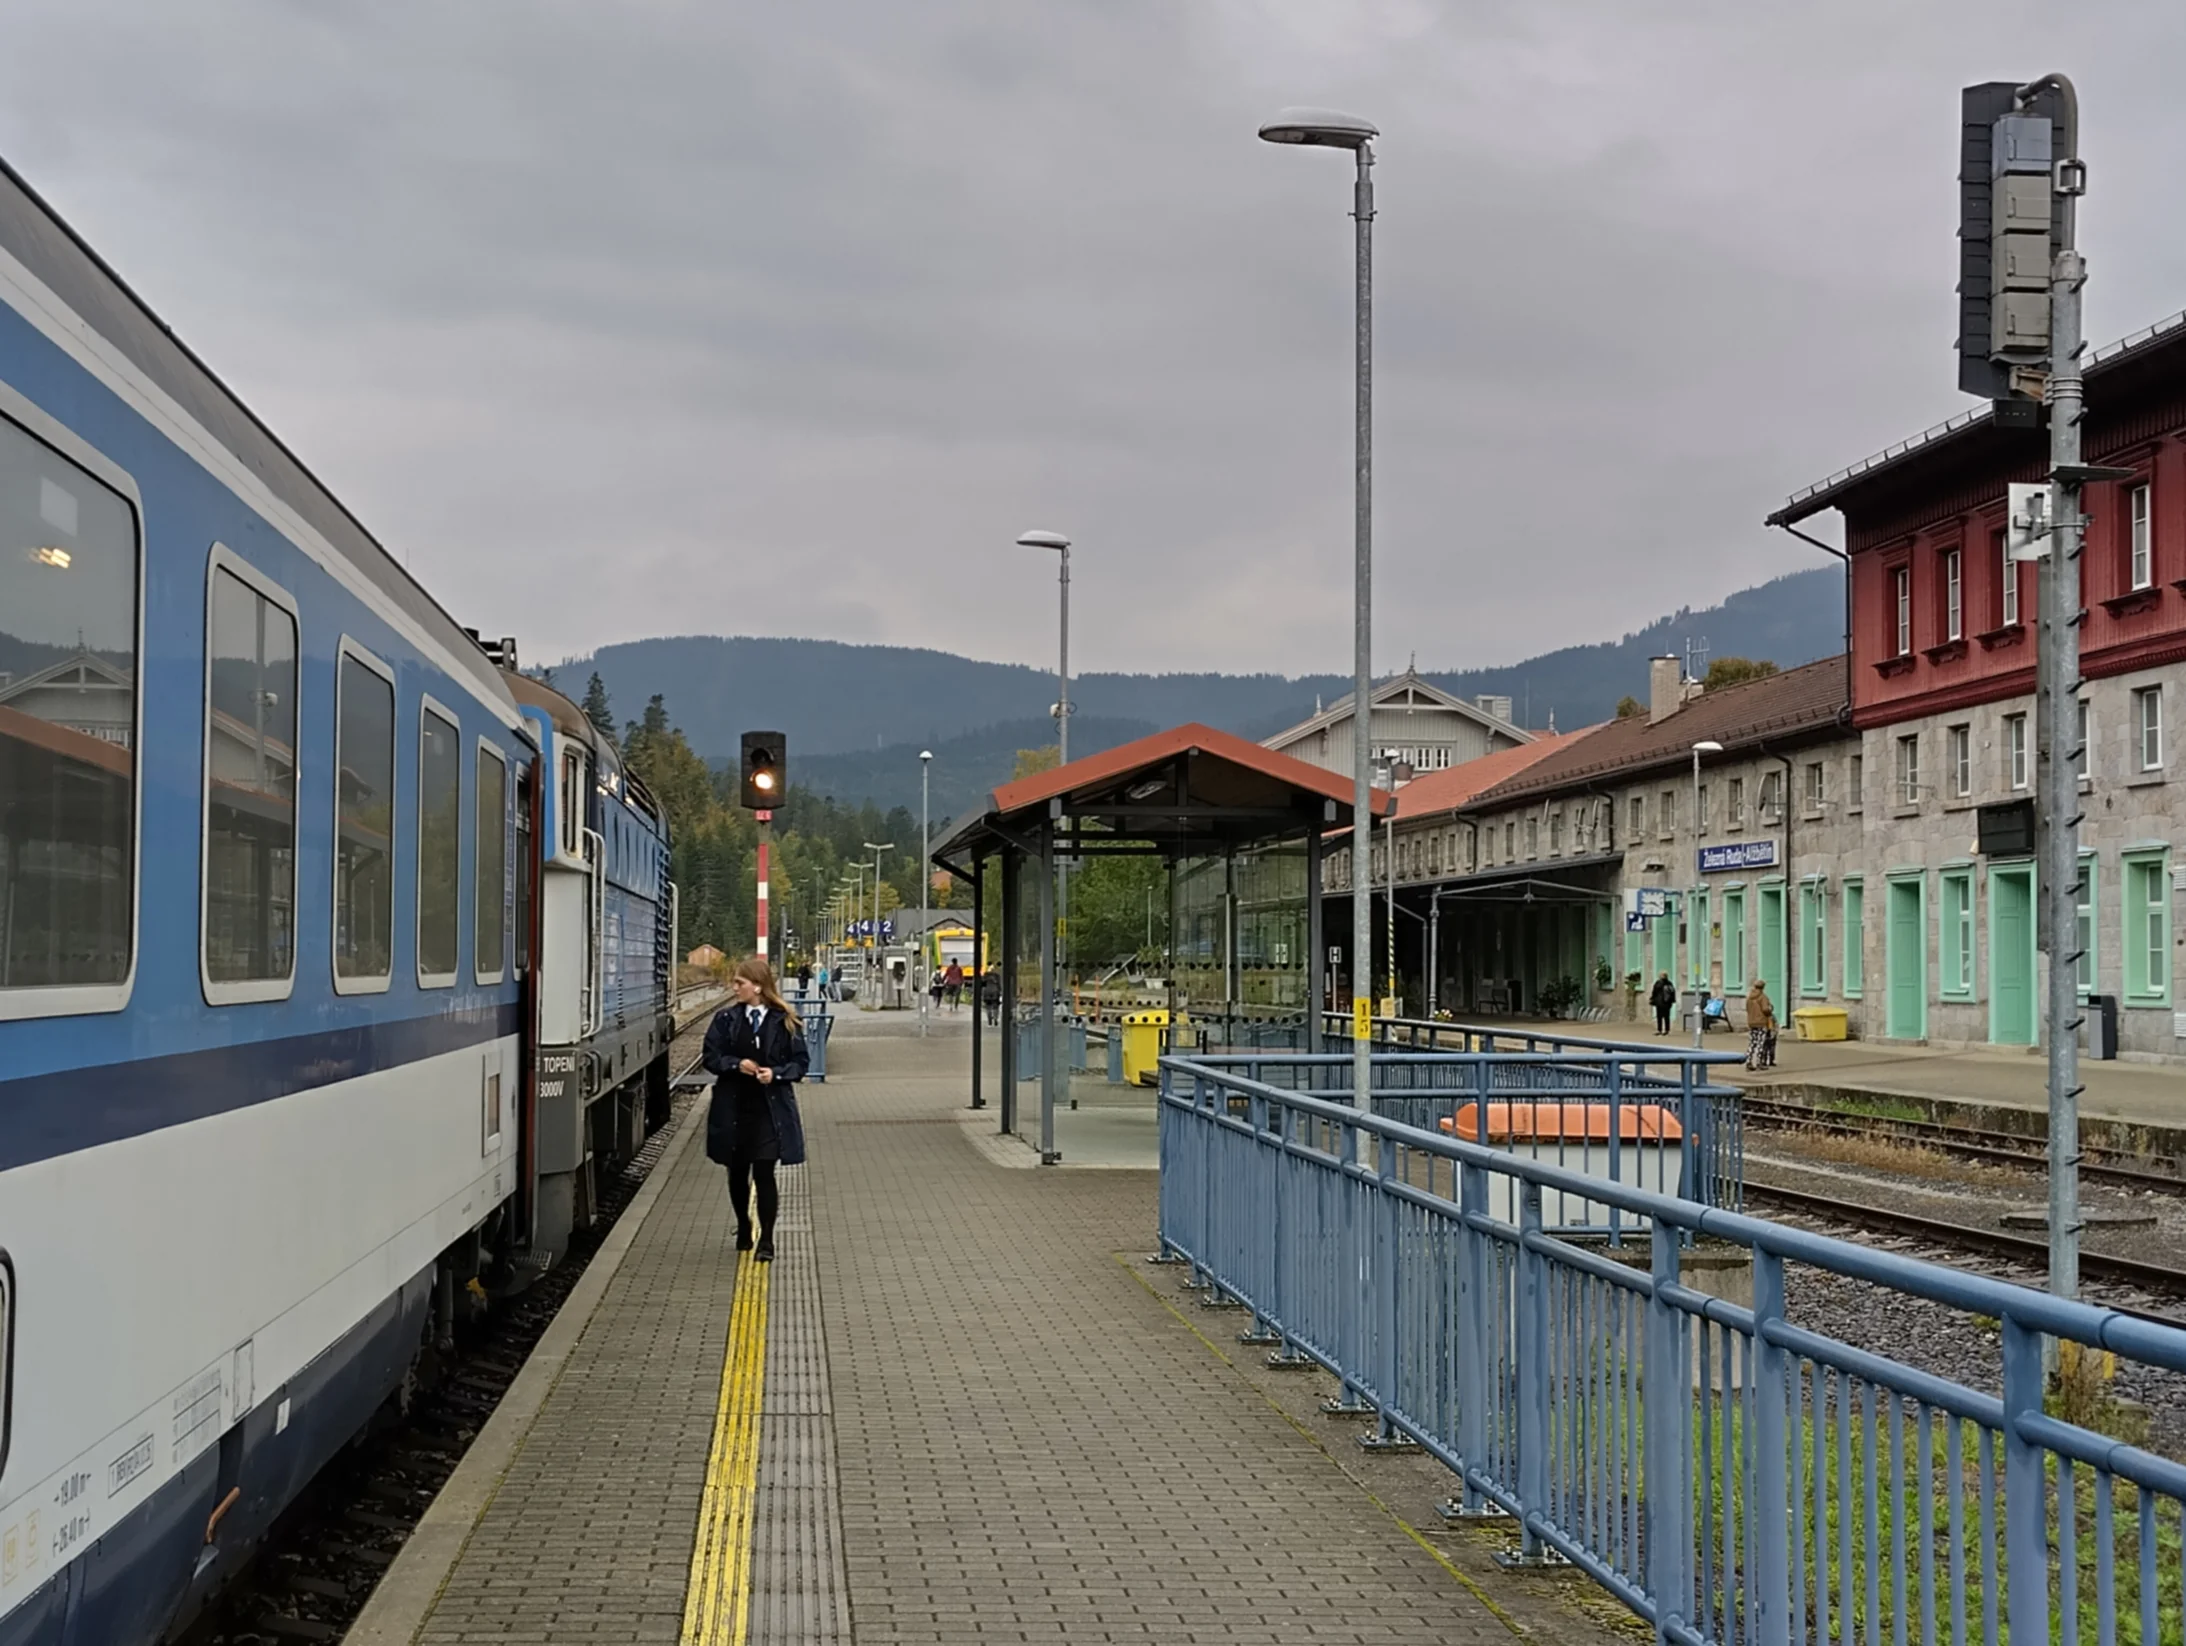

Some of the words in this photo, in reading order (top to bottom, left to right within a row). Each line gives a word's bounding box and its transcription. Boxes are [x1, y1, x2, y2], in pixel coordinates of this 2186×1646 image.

[861, 920, 869, 932] 4
[883, 920, 892, 933] 2
[543, 1051, 575, 1073] TOPENÍ
[540, 1080, 565, 1097] 3000V
